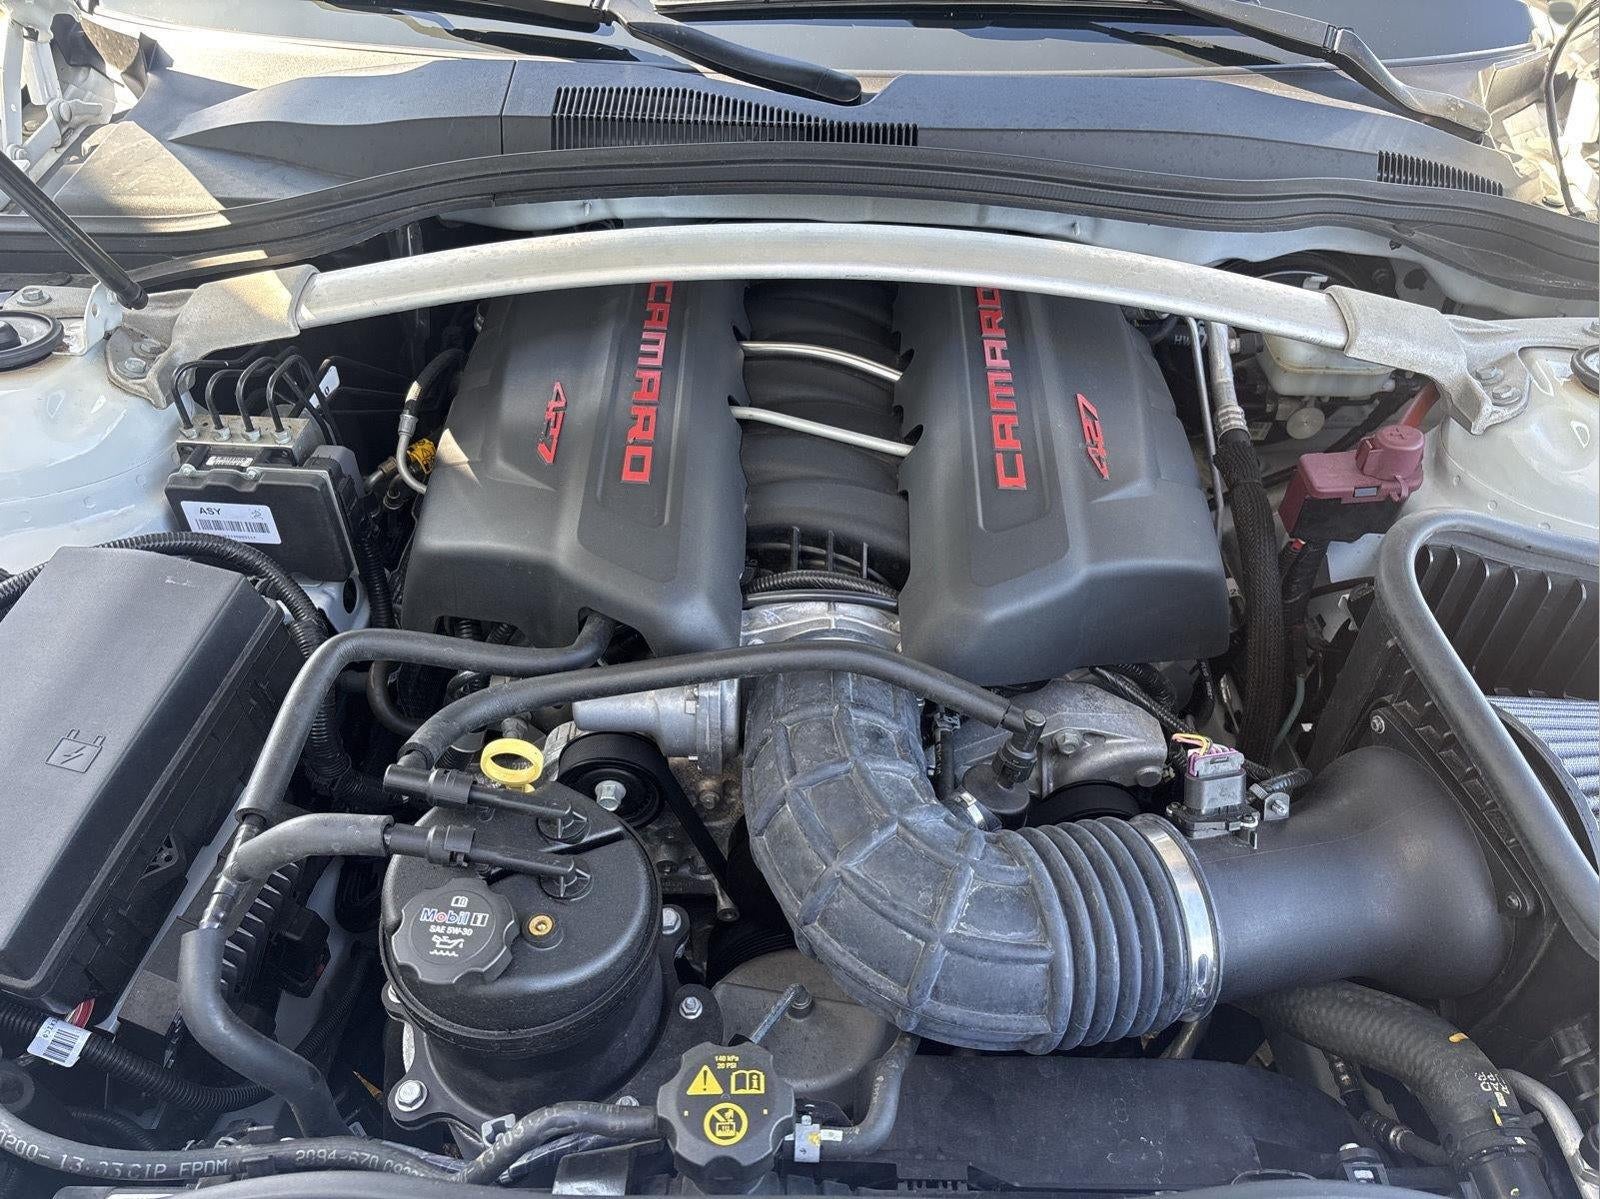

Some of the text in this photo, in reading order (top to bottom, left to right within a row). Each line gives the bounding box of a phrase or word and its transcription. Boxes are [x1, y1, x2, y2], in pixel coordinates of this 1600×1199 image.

[621, 281, 674, 484] CAMARO
[976, 286, 1028, 490] CAMARO
[1075, 393, 1110, 480] 427
[199, 507, 221, 516] ASY
[420, 907, 471, 926] Mobil
[429, 924, 473, 937] SAE 5W-30
